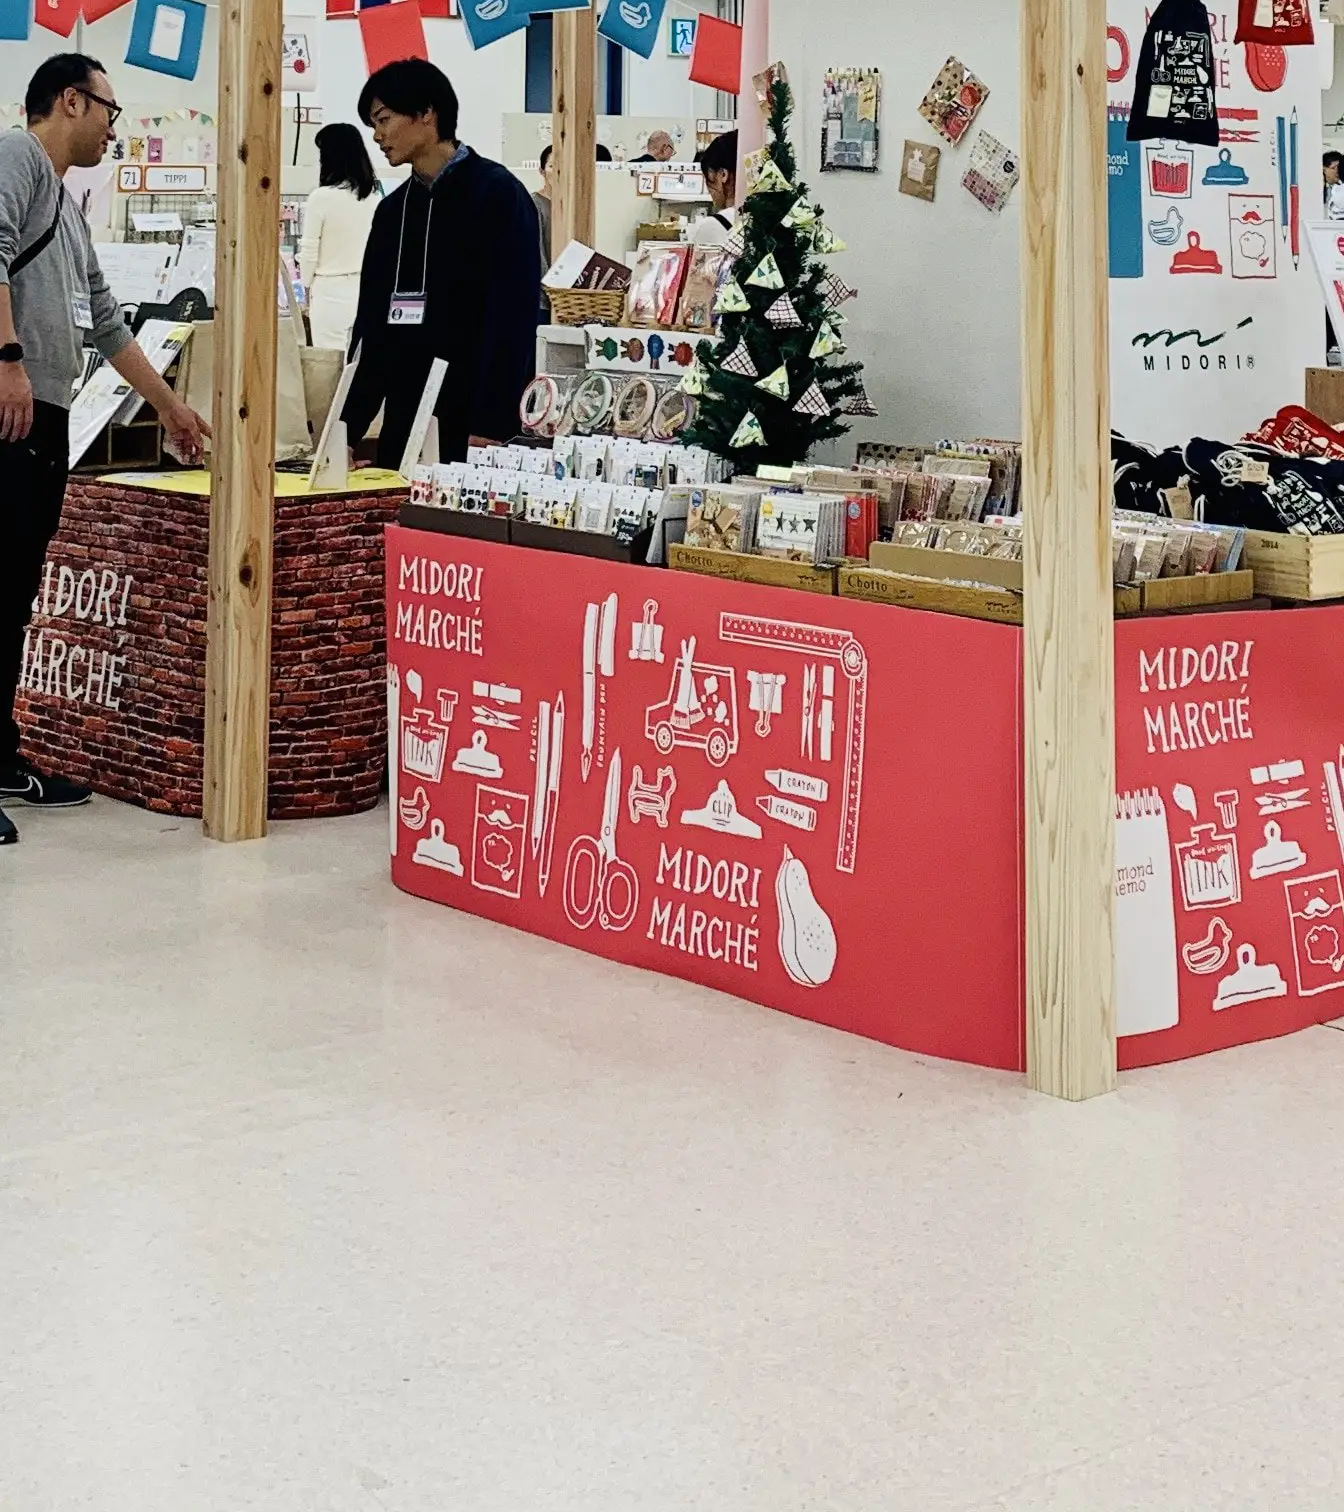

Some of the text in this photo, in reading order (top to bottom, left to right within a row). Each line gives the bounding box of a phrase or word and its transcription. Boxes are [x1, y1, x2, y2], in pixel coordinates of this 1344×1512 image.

[123, 171, 137, 186] 71
[164, 174, 187, 185] TIPPI
[641, 177, 652, 190] 72
[676, 550, 713, 568] Chotto
[398, 554, 484, 603] MIDORI
[847, 574, 888, 593] Chotto
[31, 561, 134, 628] IDORI
[394, 600, 484, 657] MARCHÉ
[1139, 640, 1255, 693] MIDORI
[1143, 684, 1254, 754] MARCHÉ
[786, 776, 818, 793] CRAYON
[712, 799, 733, 818] CLIP
[774, 803, 805, 822] CRAYON
[656, 842, 762, 908] MIDORI
[1116, 858, 1154, 880] mond
[1190, 859, 1229, 896] INK
[646, 896, 759, 972] MARCHÉ
